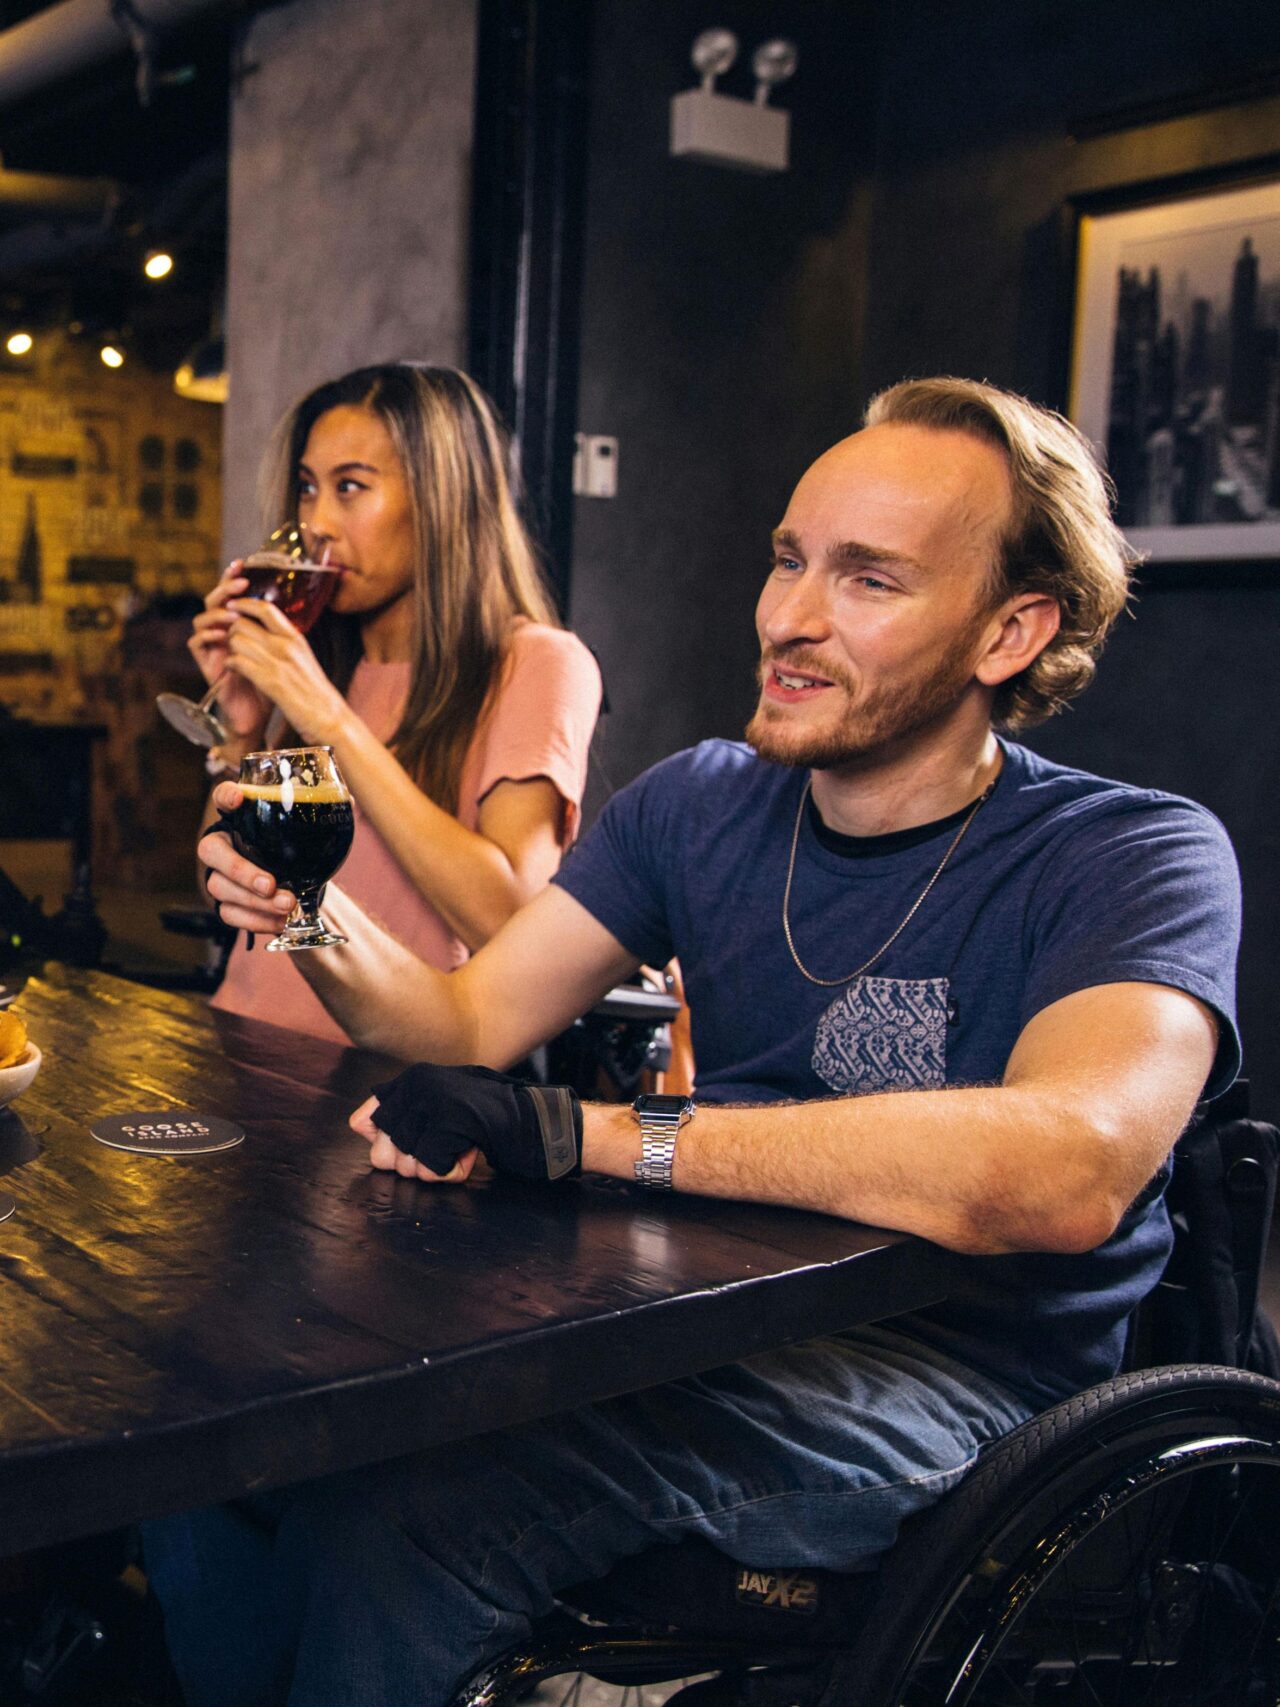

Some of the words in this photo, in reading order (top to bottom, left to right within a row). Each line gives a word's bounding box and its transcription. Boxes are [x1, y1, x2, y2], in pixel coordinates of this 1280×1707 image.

[320, 813, 351, 825] COUN
[121, 1121, 204, 1132] GOOSE
[127, 1127, 210, 1137] ISLAND
[738, 1571, 773, 1594] JAY
[762, 1567, 817, 1608] X2
